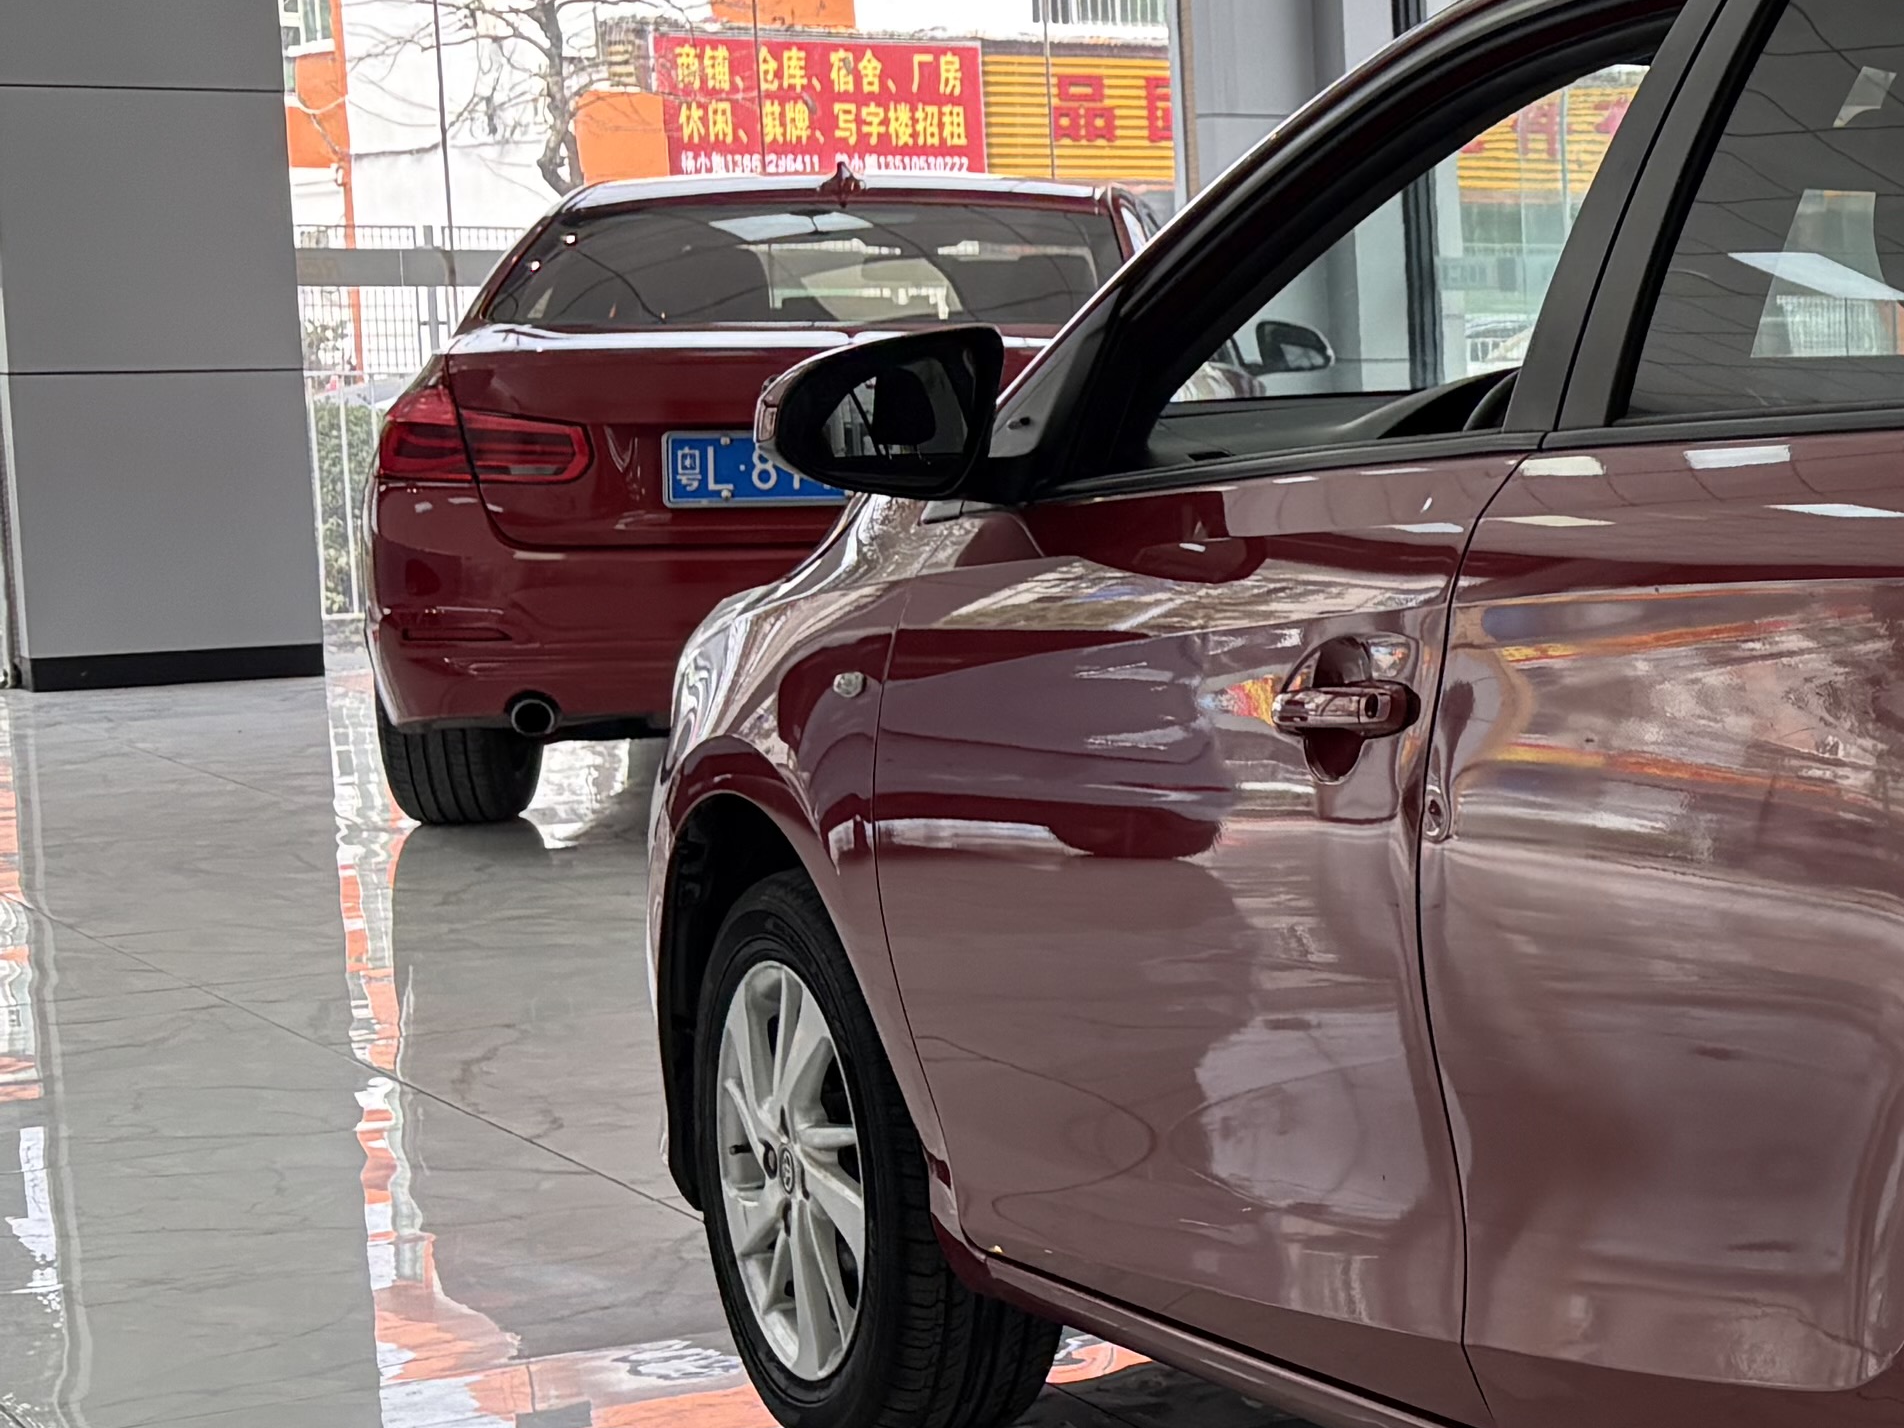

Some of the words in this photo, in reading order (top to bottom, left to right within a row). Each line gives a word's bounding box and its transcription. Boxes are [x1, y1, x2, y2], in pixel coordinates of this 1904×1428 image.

[674, 44, 963, 96] 商铺、仓库、宿舍、厂房
